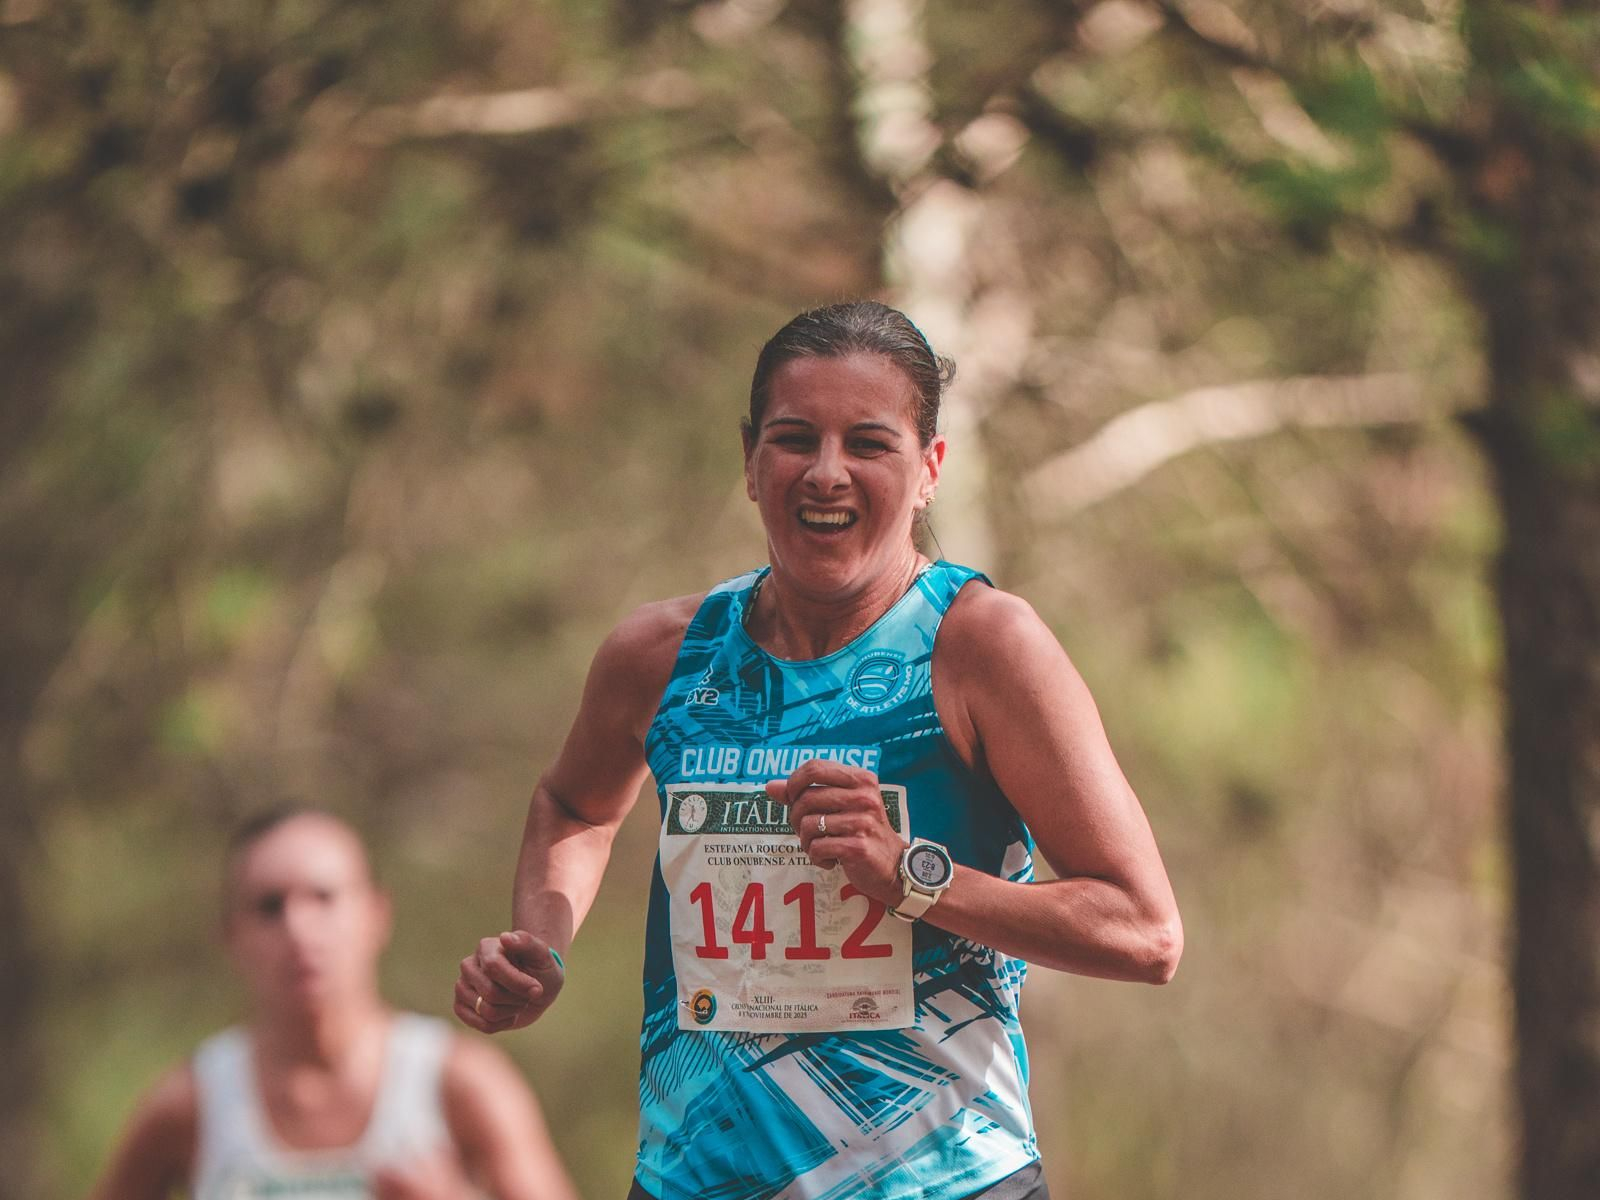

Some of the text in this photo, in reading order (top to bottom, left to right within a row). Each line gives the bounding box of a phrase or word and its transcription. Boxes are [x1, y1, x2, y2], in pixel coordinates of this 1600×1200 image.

[845, 664, 913, 714] DE ATLETISMO
[681, 747, 740, 777] CLUB
[721, 793, 789, 825] ITÁLI
[707, 857, 732, 866] CLUB
[733, 856, 786, 866] ONUBENSE
[756, 844, 794, 854] ROUCO
[689, 881, 894, 961] 1412
